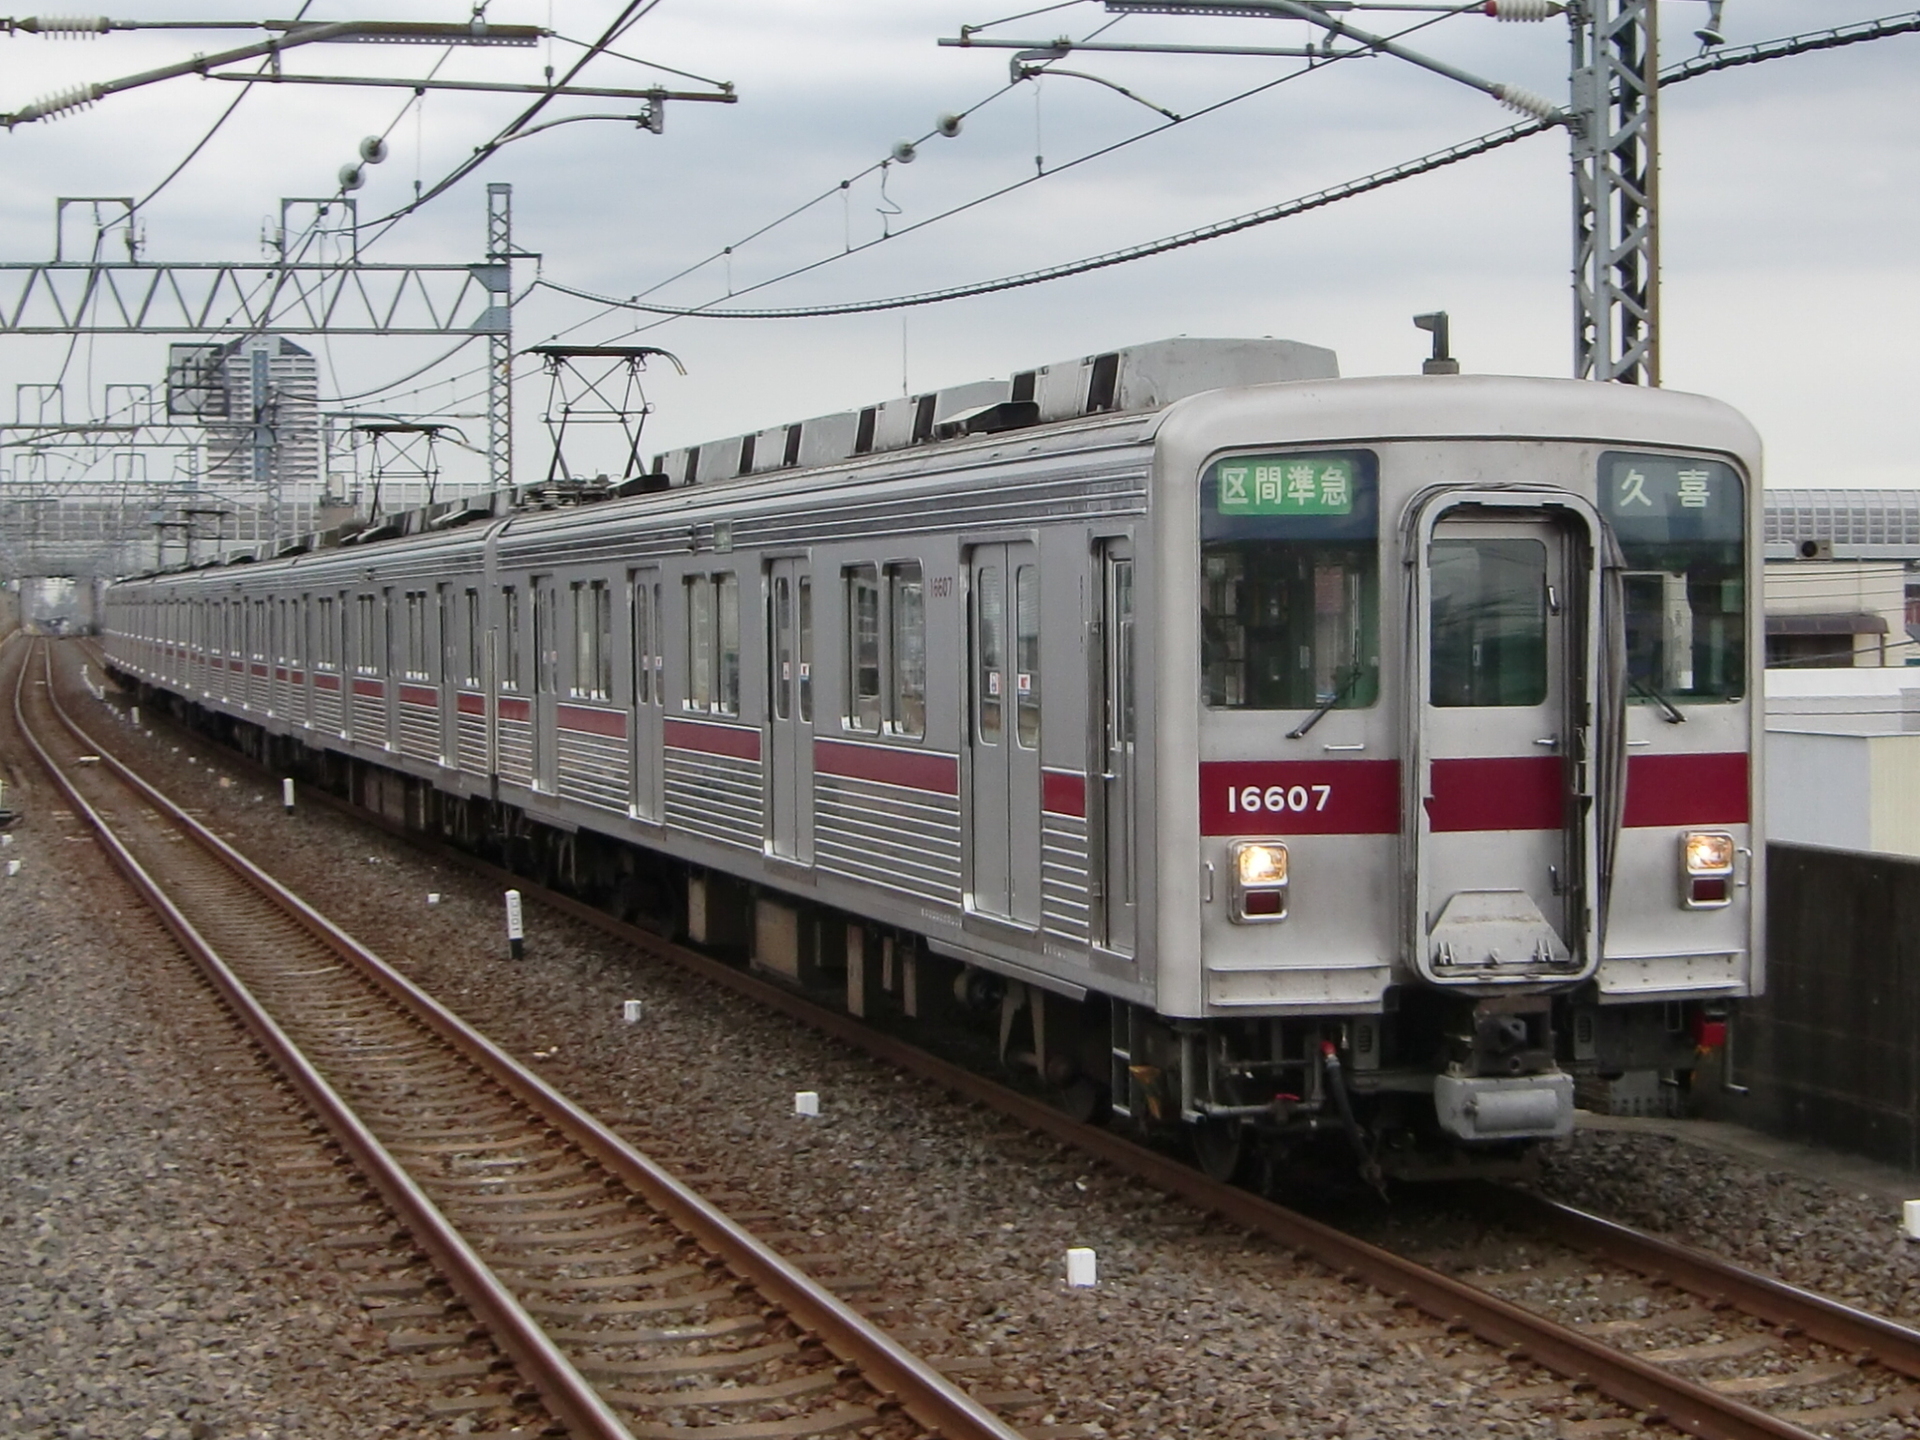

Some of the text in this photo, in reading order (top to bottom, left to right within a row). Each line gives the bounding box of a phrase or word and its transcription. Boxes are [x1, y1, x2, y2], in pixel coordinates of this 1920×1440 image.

[1222, 466, 1347, 506] 区間準急
[1620, 469, 1711, 507] 久喜
[930, 577, 953, 597] 16607
[1228, 785, 1331, 813] 16607
